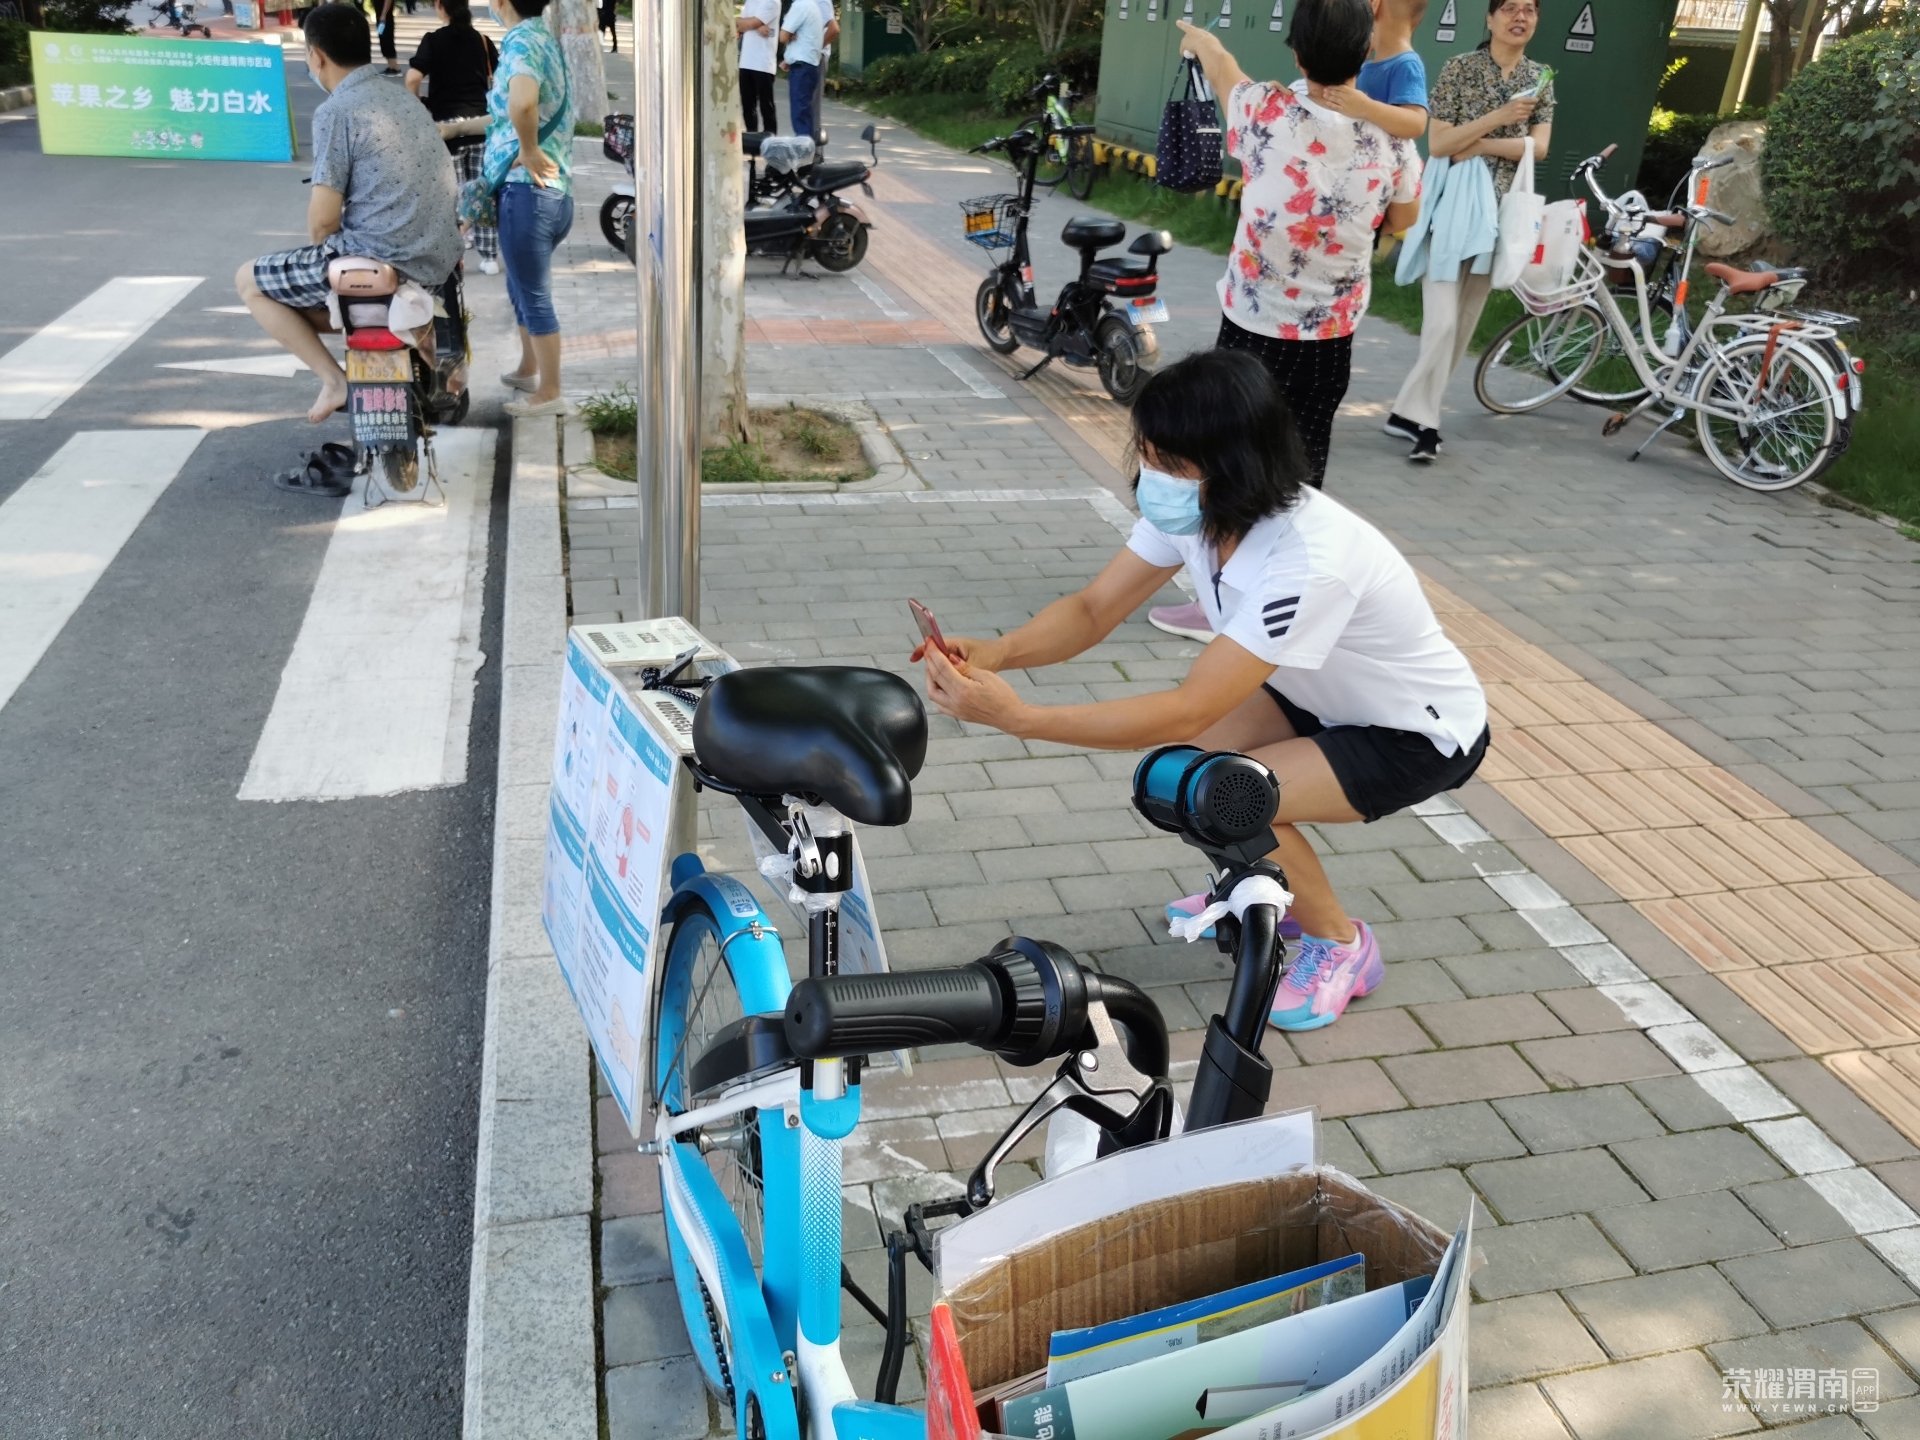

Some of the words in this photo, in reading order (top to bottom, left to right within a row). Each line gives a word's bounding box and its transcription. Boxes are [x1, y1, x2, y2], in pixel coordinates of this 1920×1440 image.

[195, 54, 272, 68] 火炬传递渭南市区站
[51, 82, 154, 110] 苹果之乡
[169, 87, 272, 114] 魅力白水
